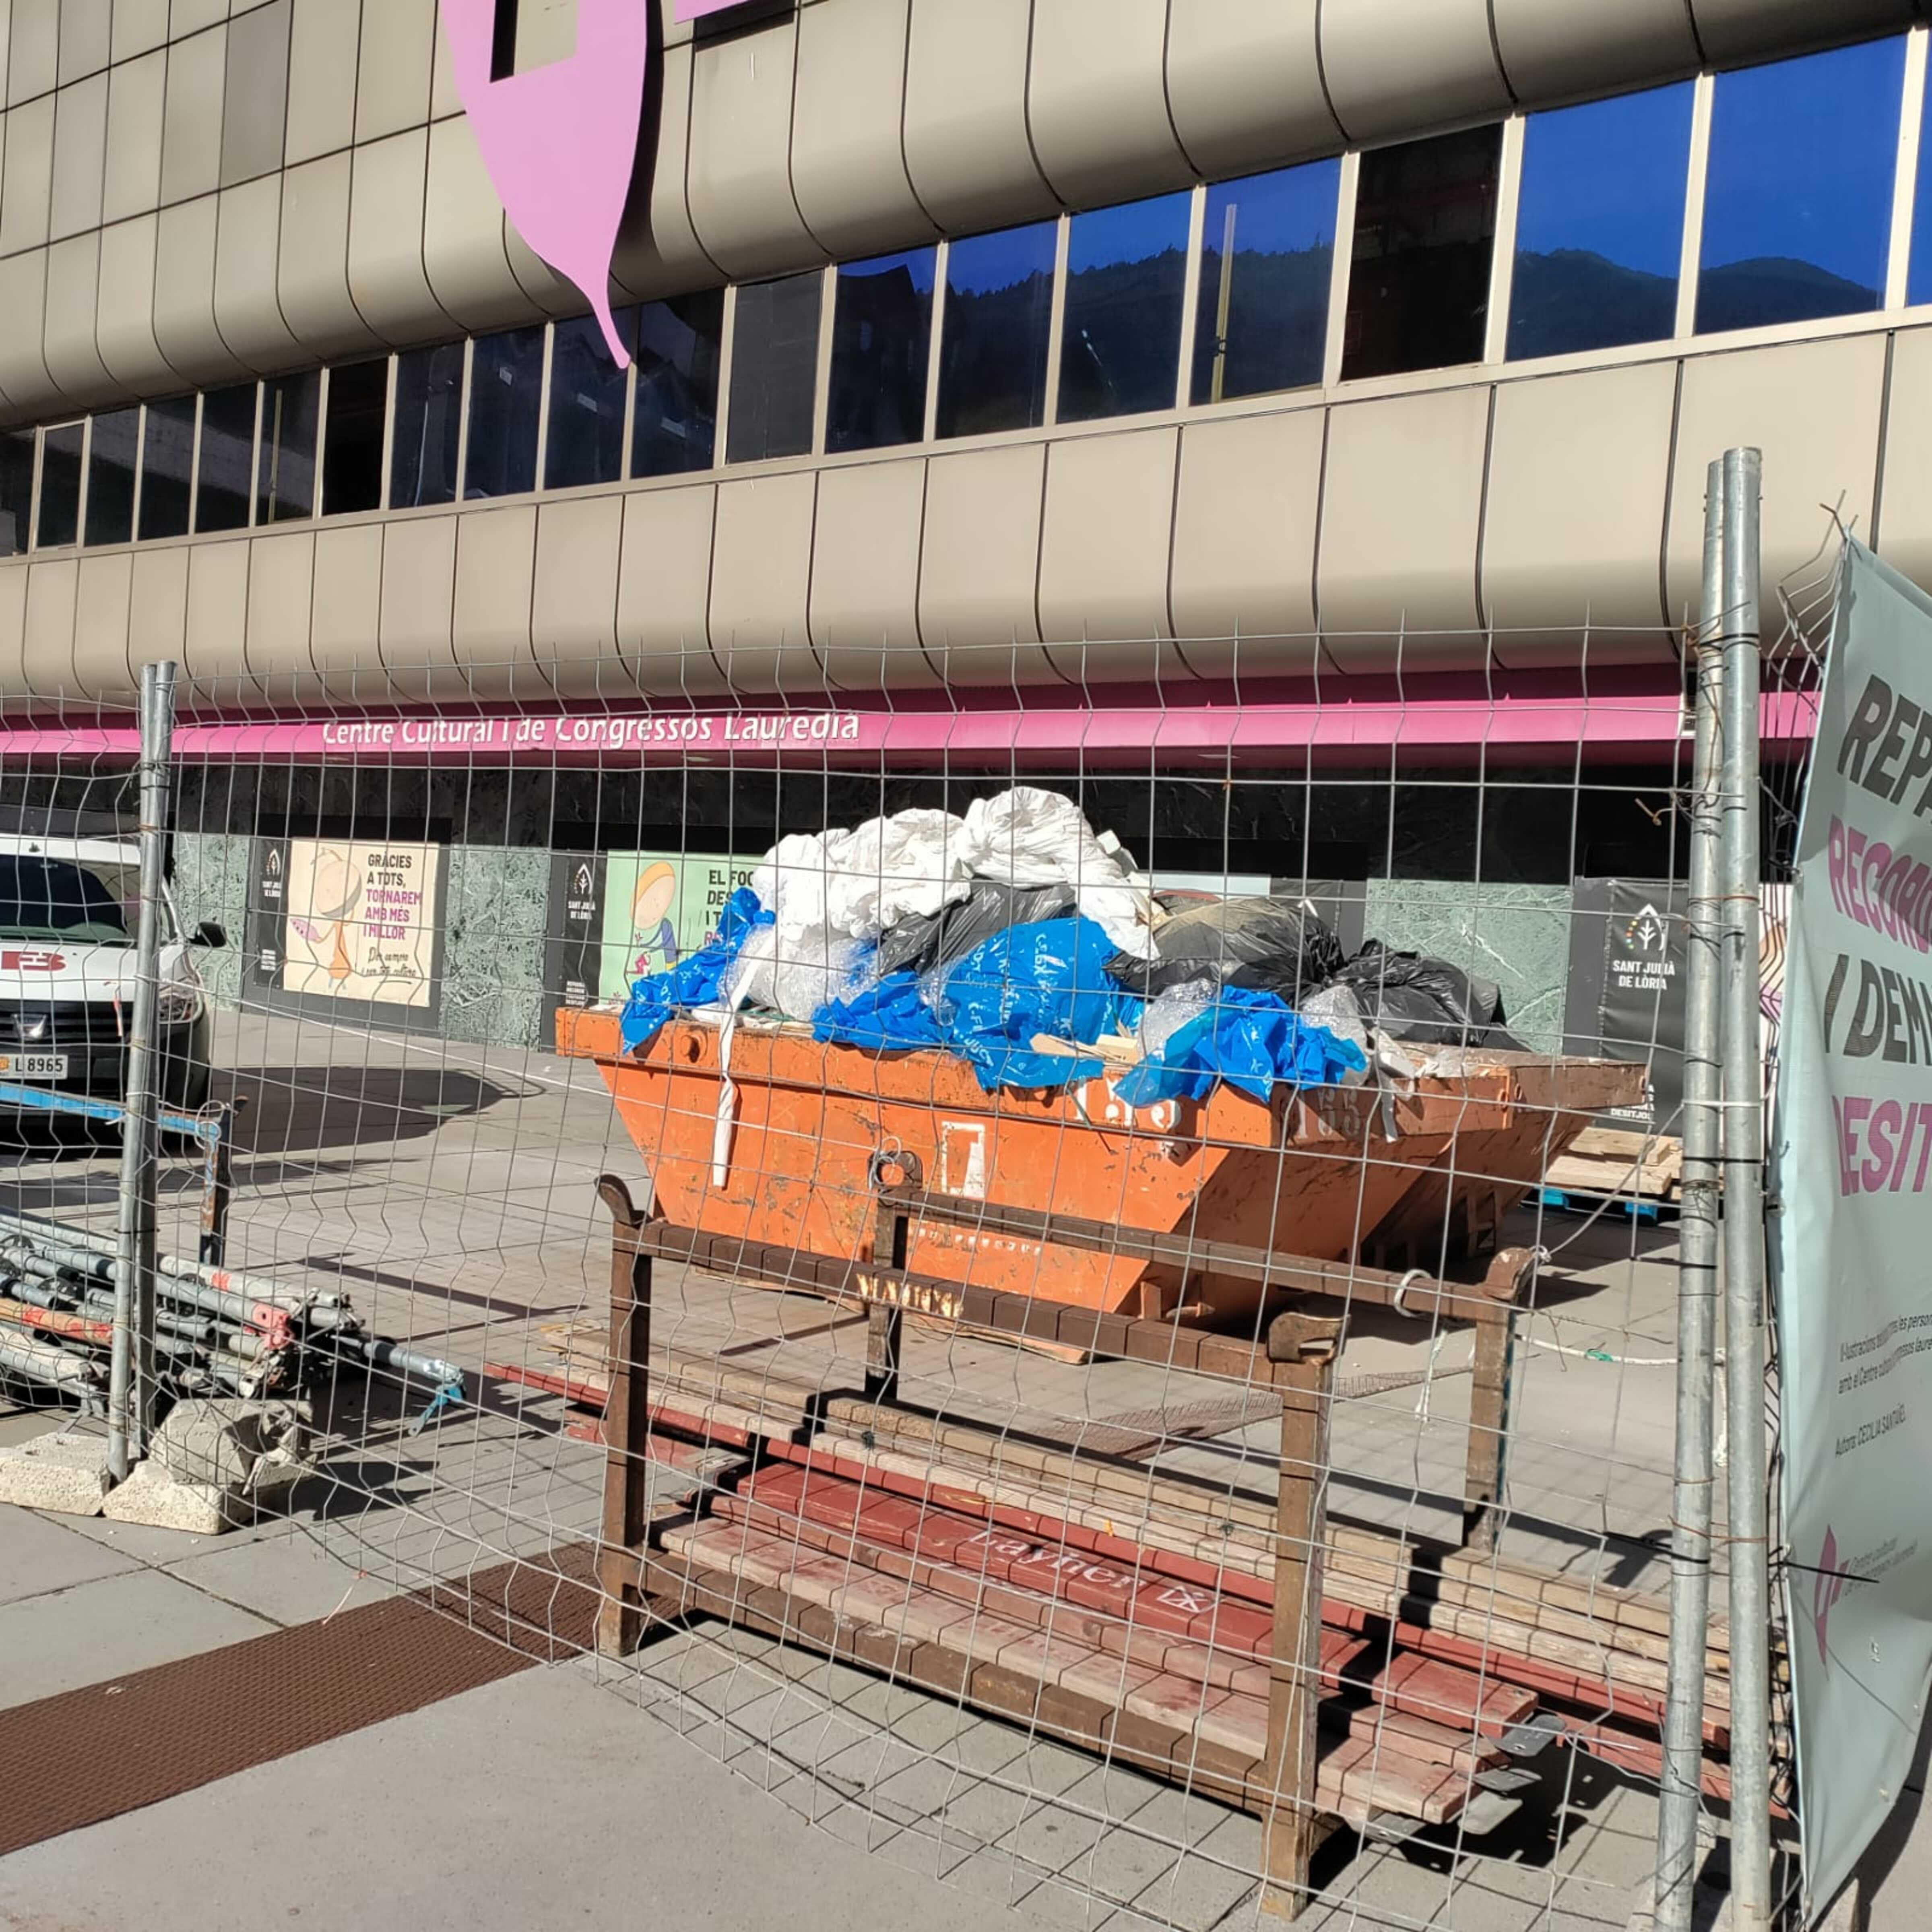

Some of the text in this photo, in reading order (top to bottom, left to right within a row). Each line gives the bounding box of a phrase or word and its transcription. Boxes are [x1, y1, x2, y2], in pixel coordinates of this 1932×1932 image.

[323, 720, 394, 744] Centre
[402, 718, 493, 743] Cultural
[516, 717, 545, 741] de
[556, 717, 712, 749] Congressos
[367, 871, 374, 884] A
[709, 870, 726, 885] EL
[366, 888, 422, 905] TORNAREM
[365, 906, 410, 922] AMB MÉS
[1613, 960, 1642, 973] SANT
[1619, 975, 1633, 987] DE
[27, 1057, 63, 1072] 8965
